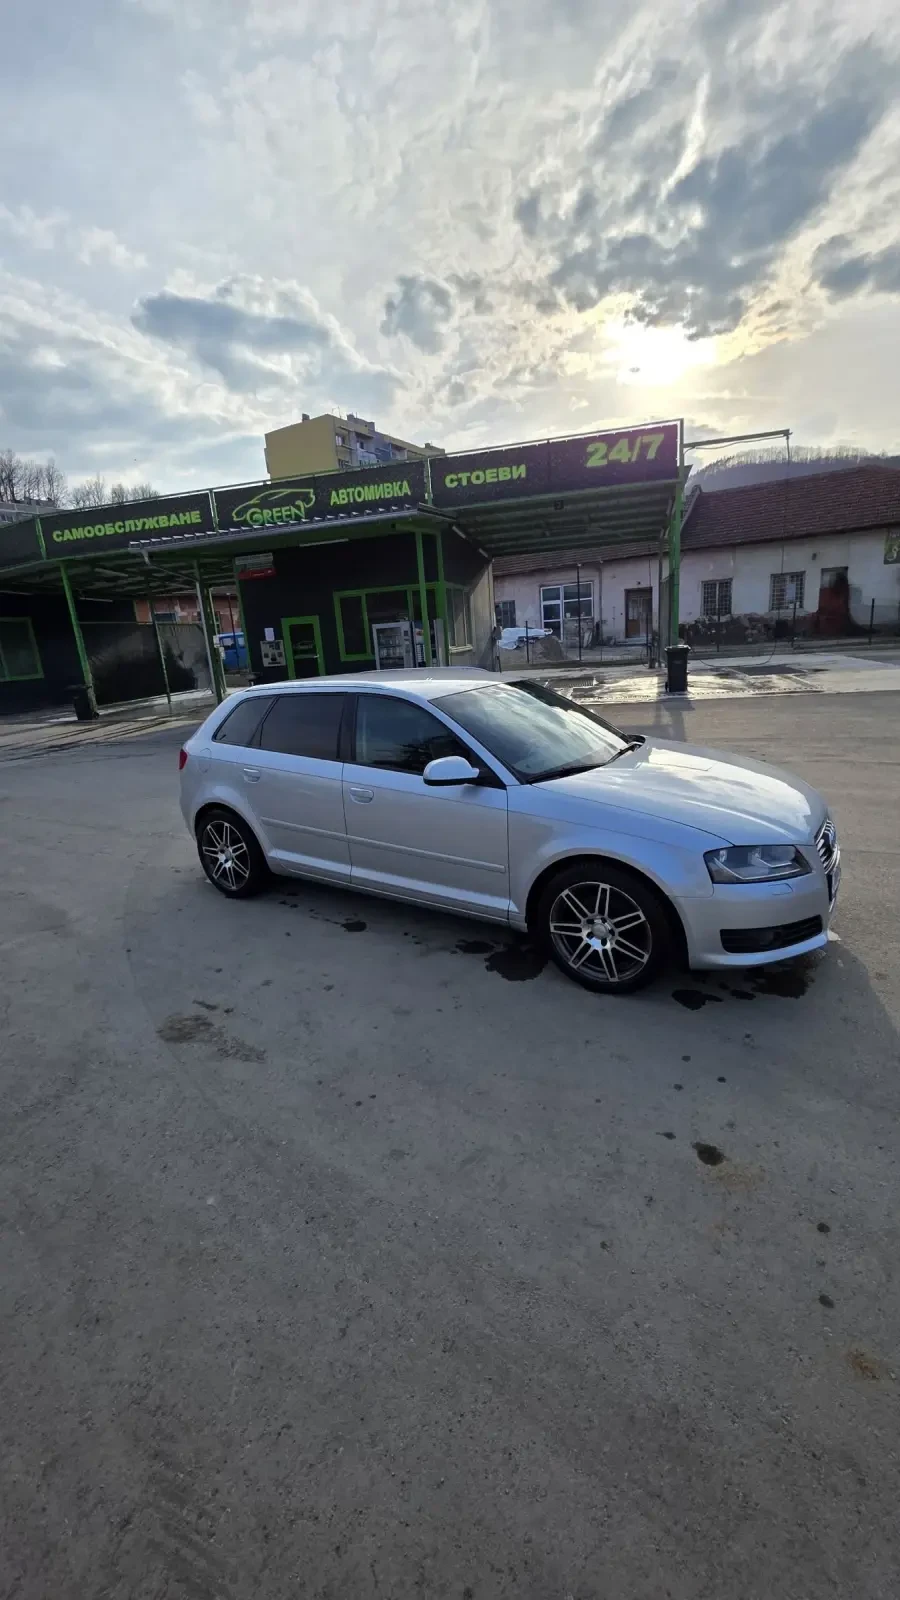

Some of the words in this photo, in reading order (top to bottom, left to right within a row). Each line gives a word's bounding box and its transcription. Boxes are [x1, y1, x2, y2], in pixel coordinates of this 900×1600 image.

[585, 433, 664, 468] 24/7
[444, 464, 527, 488] СТОЕВИ
[330, 480, 411, 506] АВТОМИВКА
[52, 510, 202, 542] САМООБСЛУЖВАНЕ
[246, 501, 306, 526] GREEN
